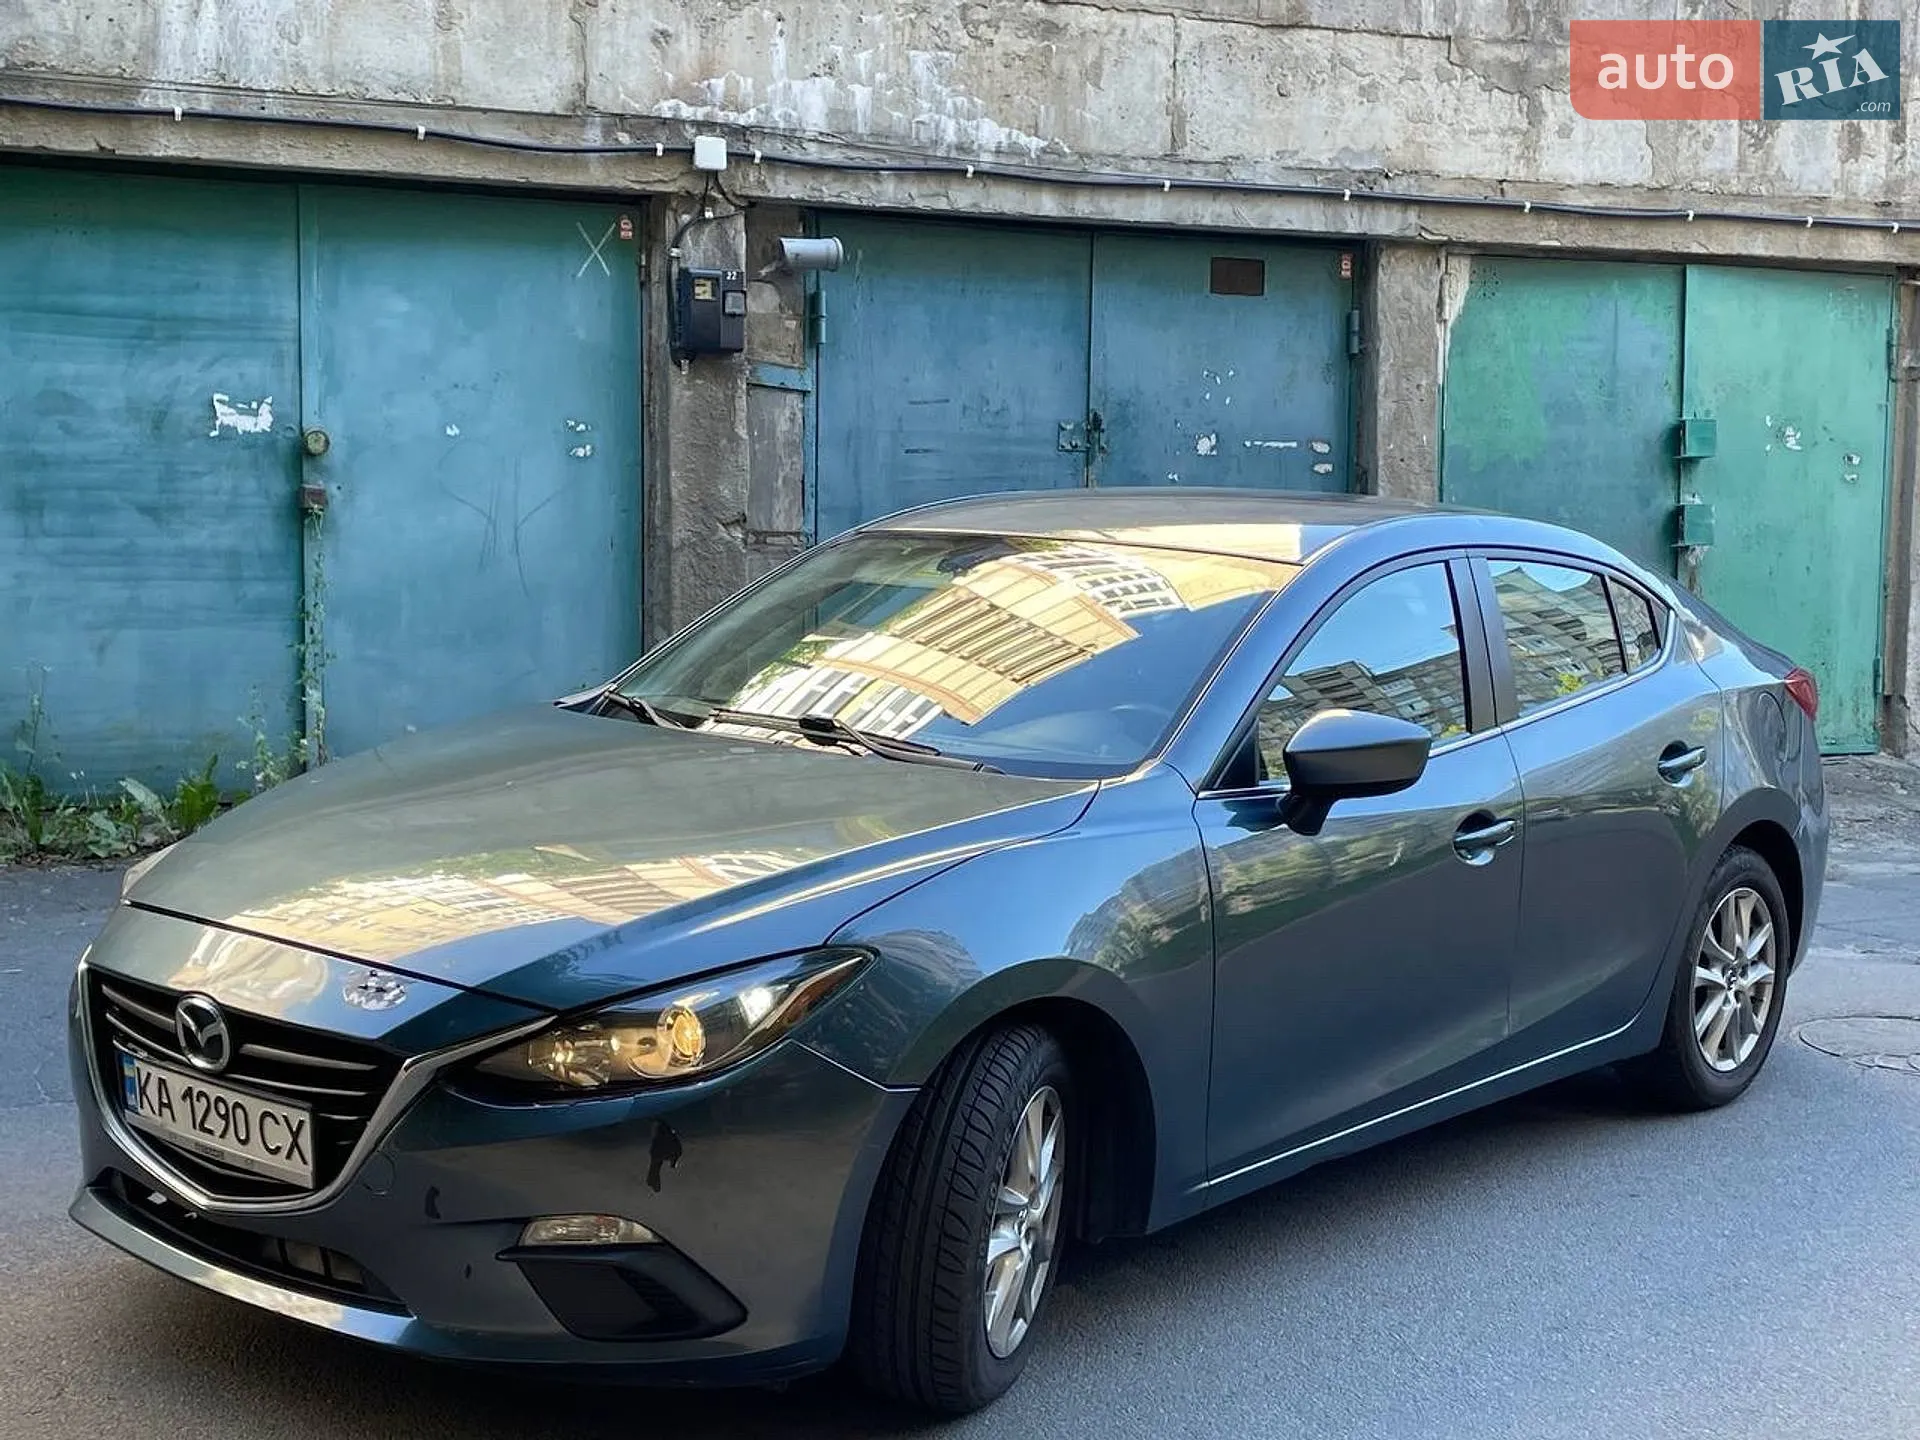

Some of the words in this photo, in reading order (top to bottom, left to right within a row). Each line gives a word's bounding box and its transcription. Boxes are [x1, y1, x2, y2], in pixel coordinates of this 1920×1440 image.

[136, 1066, 176, 1123] KA
[181, 1085, 250, 1146] 1290
[259, 1110, 309, 1166] CX
